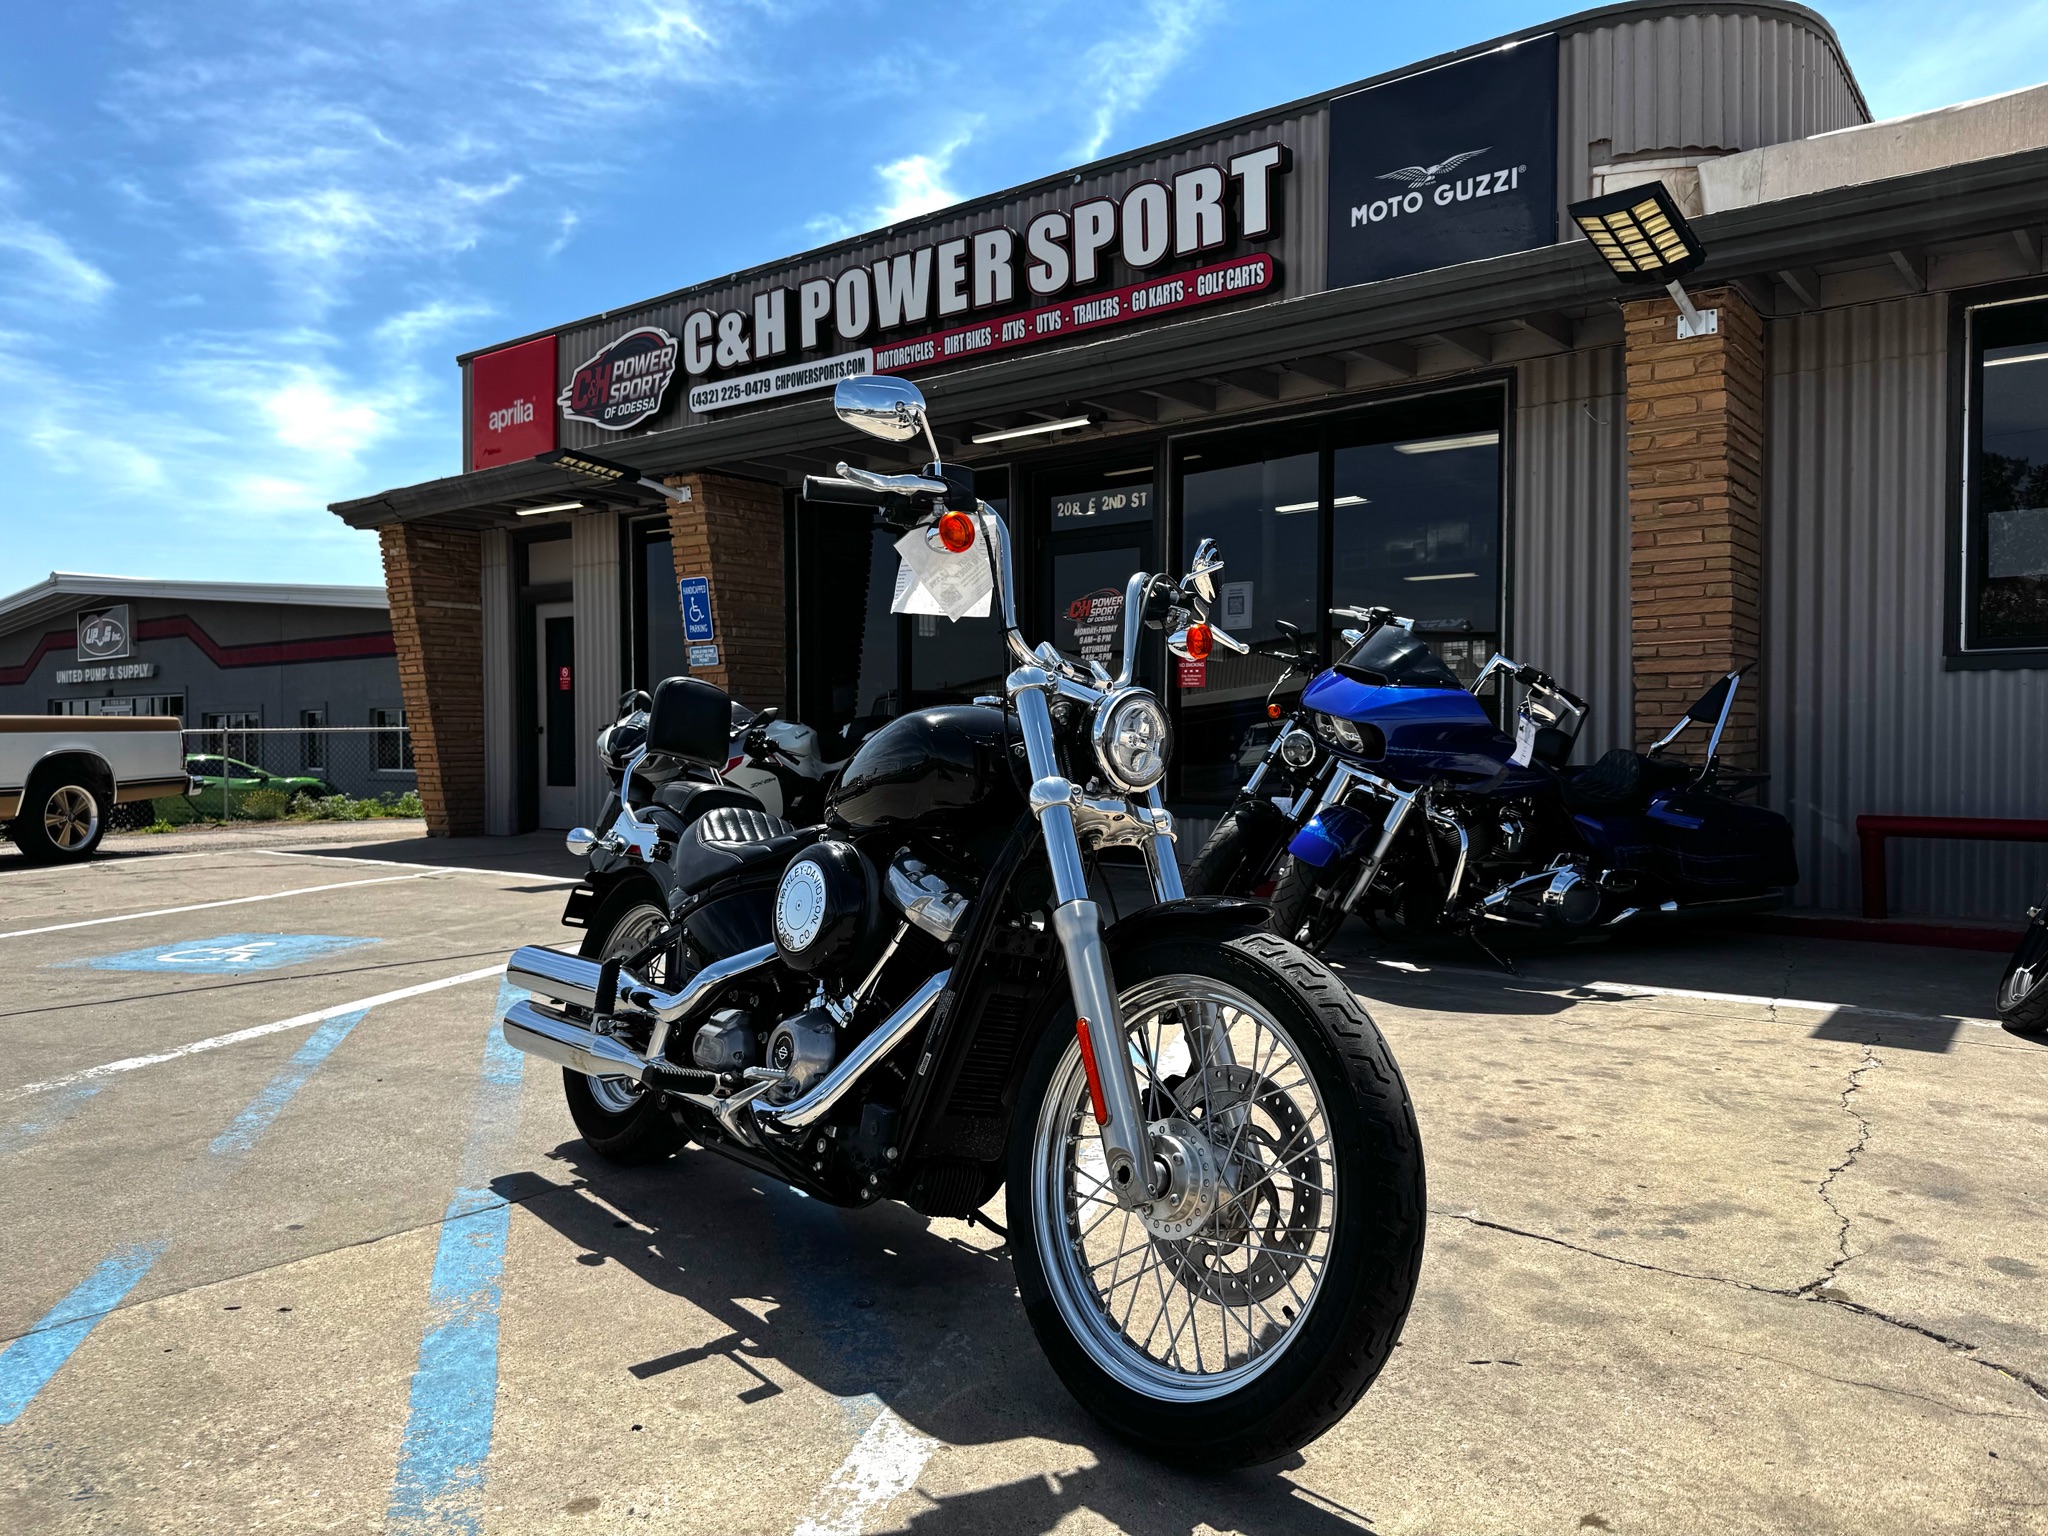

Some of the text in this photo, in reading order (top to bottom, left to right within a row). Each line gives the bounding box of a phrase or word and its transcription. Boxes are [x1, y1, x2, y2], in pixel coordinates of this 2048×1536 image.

[1351, 191, 1424, 228] MOTO
[683, 144, 1281, 376] C&H POWER SPORT
[876, 340, 935, 371] MOTORCYCLES
[943, 336, 965, 356] DIRT
[965, 326, 992, 351] BIKES
[1001, 318, 1026, 342] ATVS
[1036, 309, 1062, 334] UTVS
[1072, 296, 1120, 325] TRAILERS
[1131, 291, 1147, 312] GO
[1148, 280, 1184, 308] KARTS
[1196, 270, 1225, 297] GOLF
[1226, 261, 1265, 290] CARTS
[612, 347, 673, 382] POWER
[571, 364, 664, 410] C&H SPORT
[691, 356, 866, 408] (432) 225-0479 CHPOWERSPORTS.COM
[488, 398, 534, 433] aprilia
[604, 397, 656, 419] OF ODESSA
[1057, 491, 1148, 517] 208 E 2ND ST
[1069, 600, 1119, 619] C&H SPORT
[1091, 595, 1124, 608] POWER
[689, 623, 708, 633] PARKING
[1074, 624, 1118, 637] MONDAY-FRIDAY
[1094, 615, 1115, 624] ODESSA
[1081, 643, 1112, 655] SATURDAY
[56, 663, 149, 684] UNITED PUMP & SUPPLY
